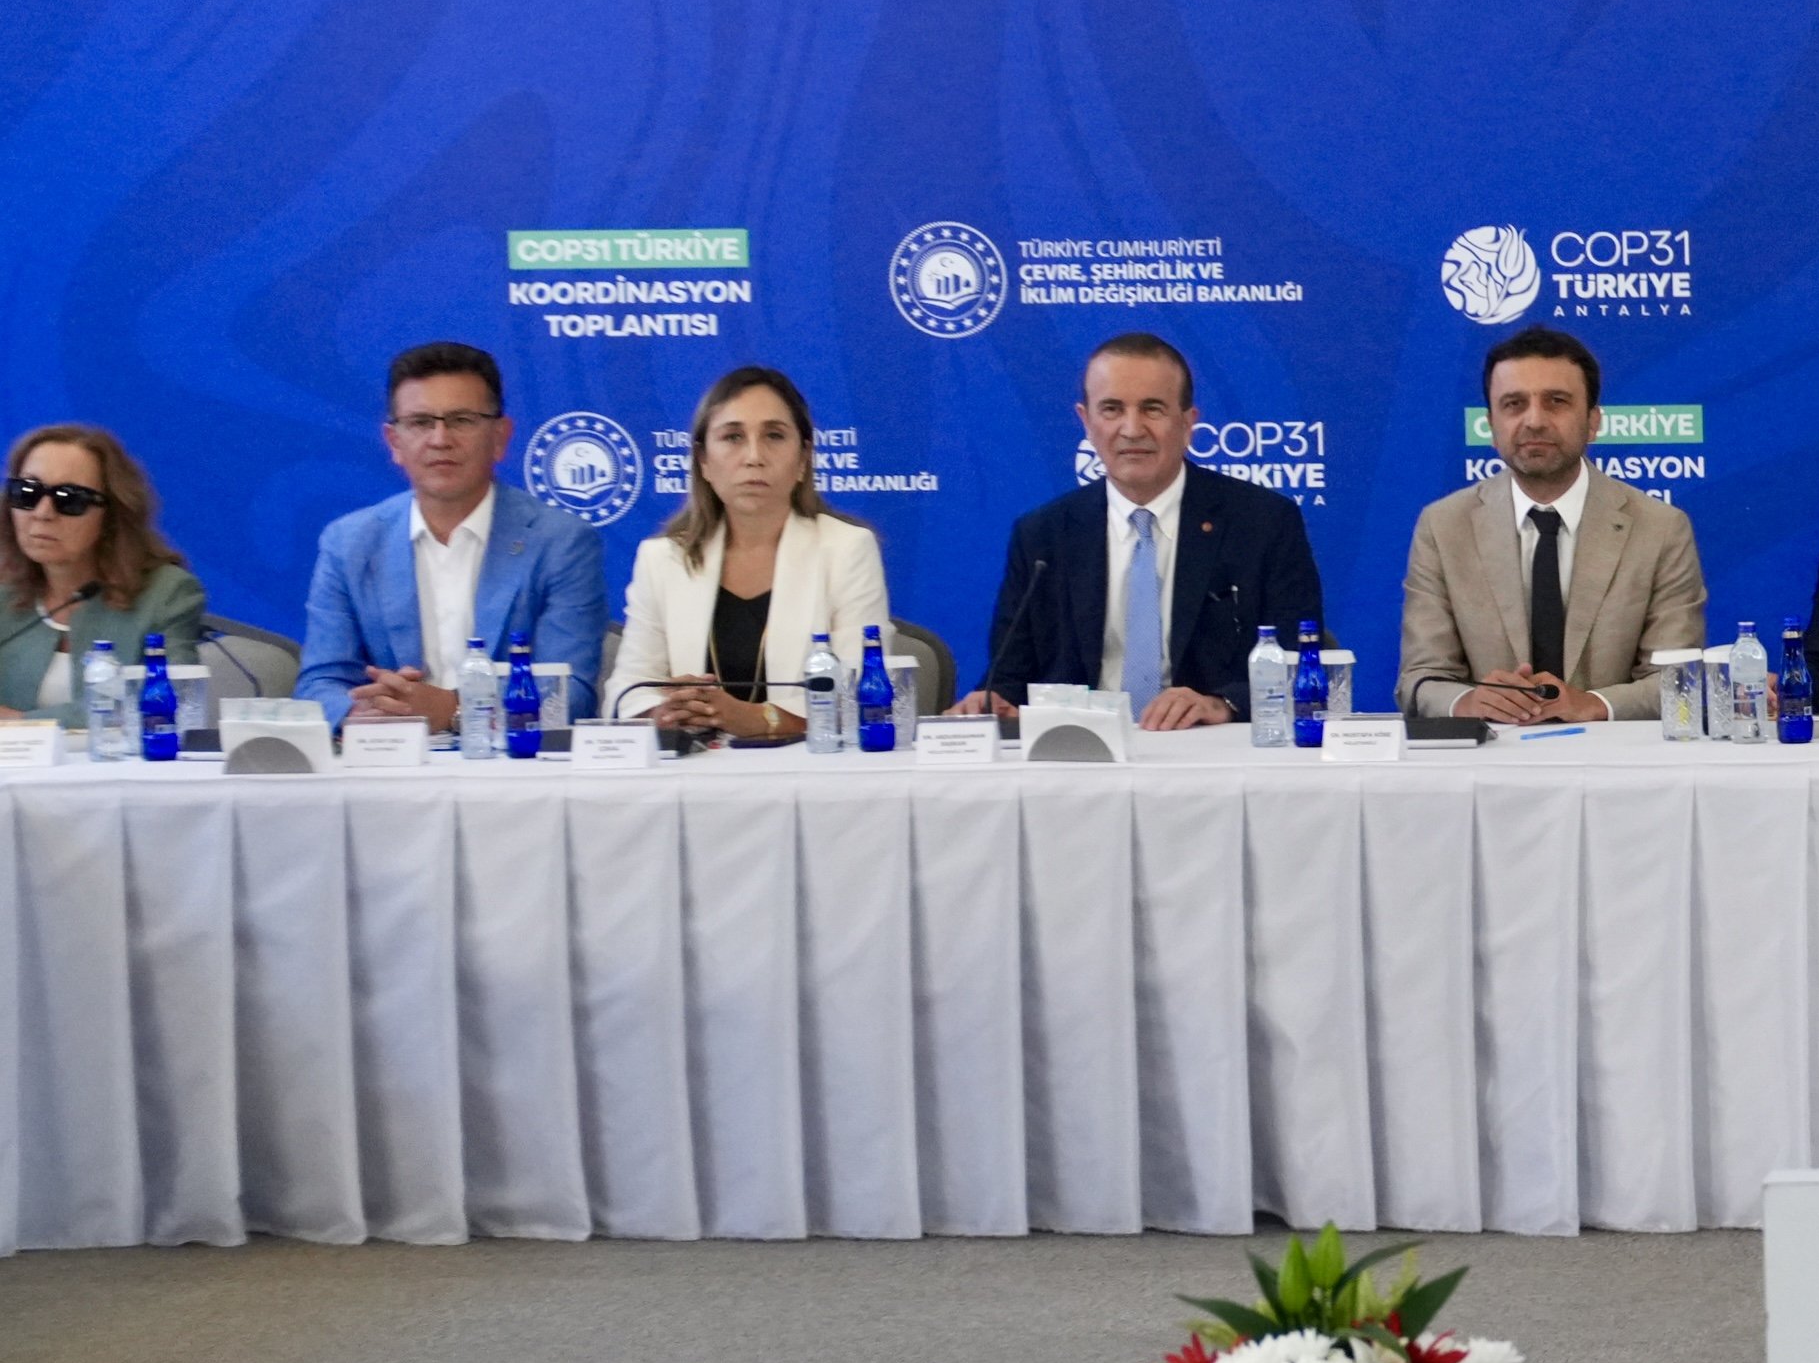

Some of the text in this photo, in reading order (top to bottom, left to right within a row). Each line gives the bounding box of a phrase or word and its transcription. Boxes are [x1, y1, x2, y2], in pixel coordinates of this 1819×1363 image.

[517, 230, 740, 262] COP31 TÜRKİYE
[1018, 237, 1221, 258] TÜRKİYE CUMHURİYETİ
[1551, 230, 1690, 267] COP31
[1018, 259, 1224, 285] ÇEVRE, ŞEHİRCİLİK VE
[509, 275, 751, 304] KOORDİNASYON
[1021, 281, 1303, 307] İKLİM DEĞİŞİKLİĞİ BAKANLIĞI
[1554, 304, 1691, 316] ANTALYA
[544, 313, 717, 337] TOPLANTISI
[1188, 421, 1326, 458] COP31
[834, 453, 861, 471] VE
[834, 472, 938, 492] BAKANLIĞI
